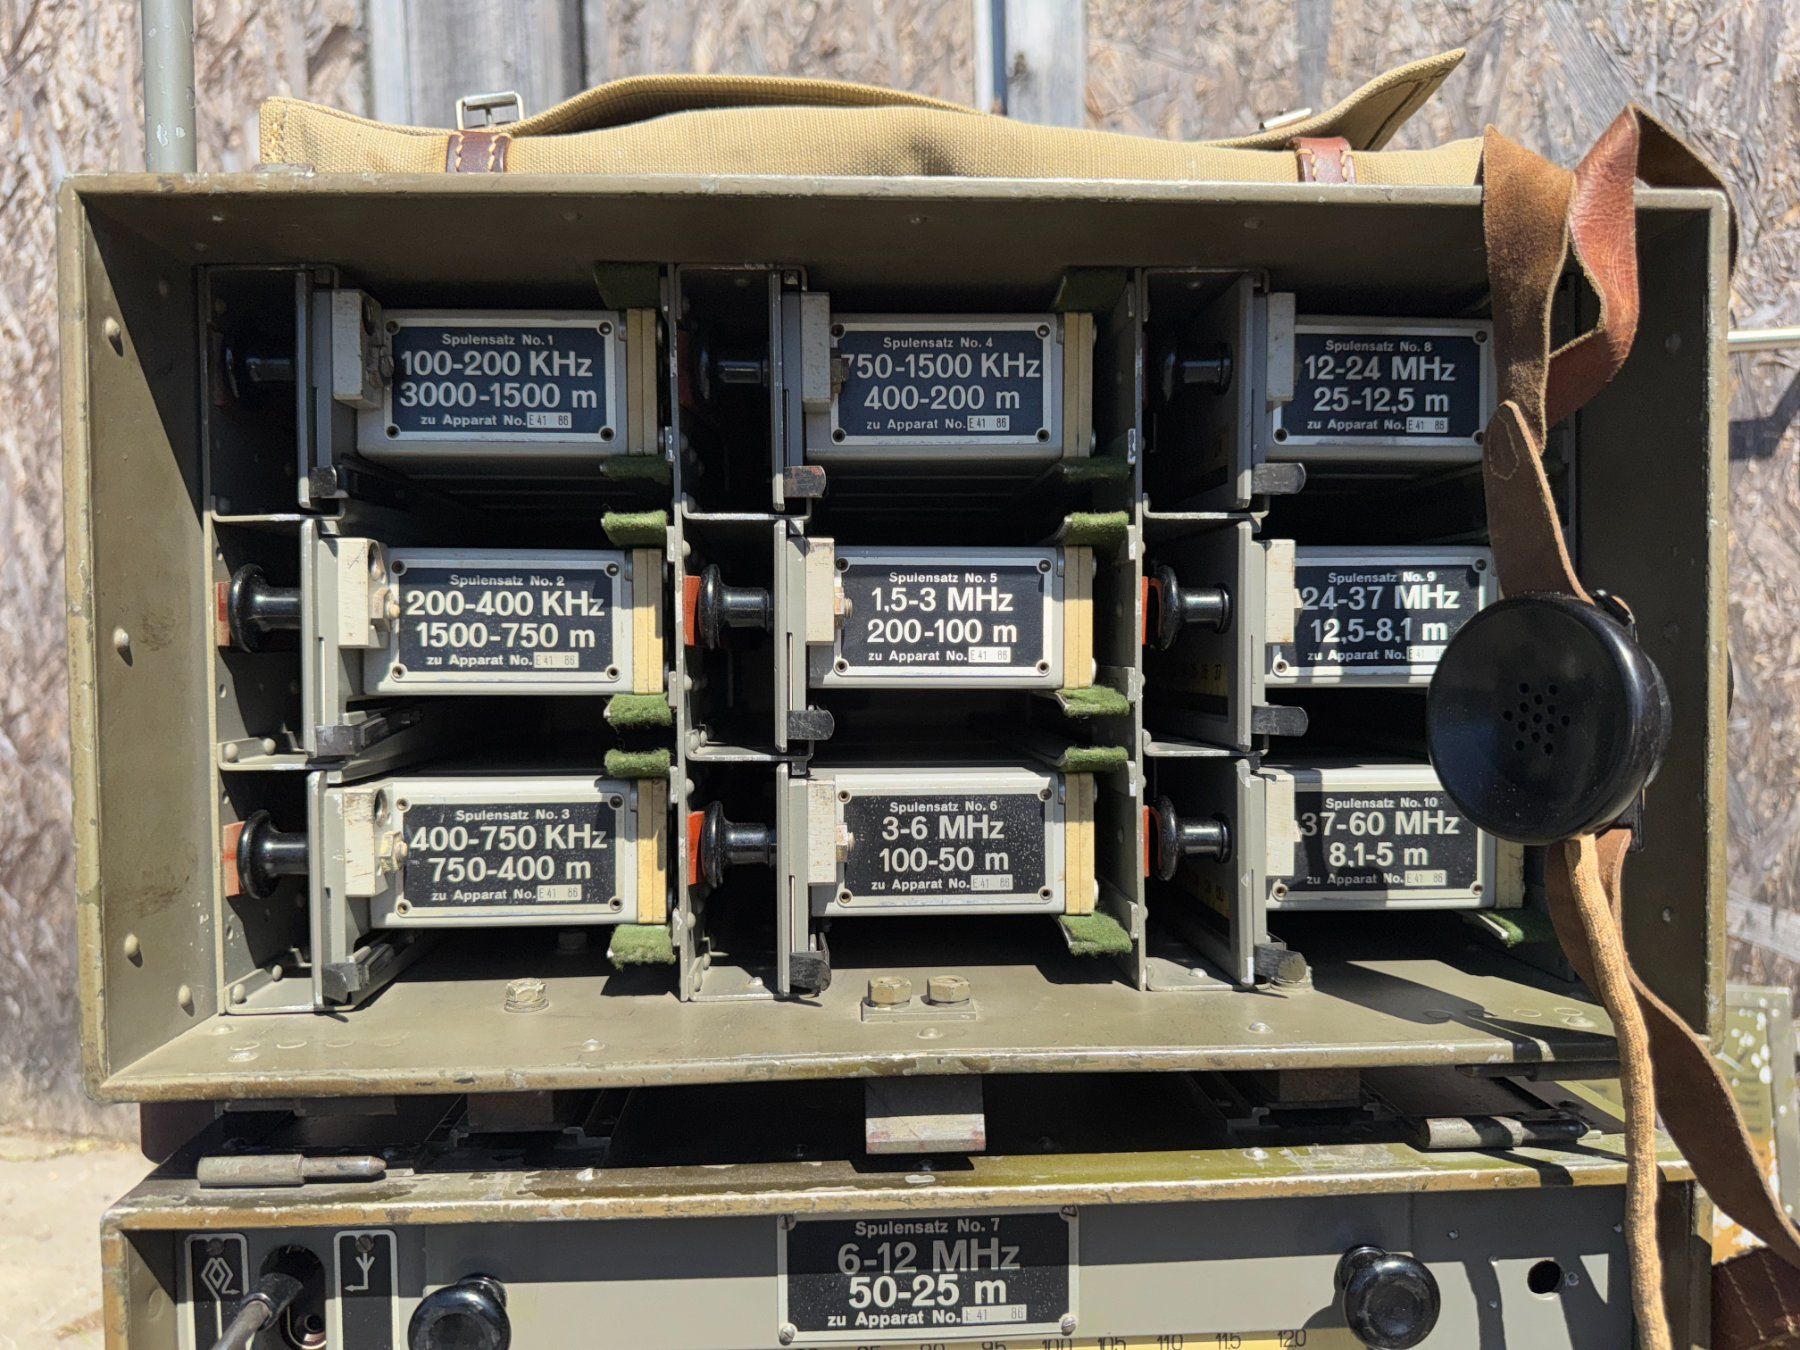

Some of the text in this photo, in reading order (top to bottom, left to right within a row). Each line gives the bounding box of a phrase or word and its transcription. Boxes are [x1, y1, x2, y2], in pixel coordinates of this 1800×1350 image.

[442, 334, 553, 347] Spulensatz No. 1
[883, 337, 993, 349] Spulensatz No. 4
[1325, 340, 1431, 352] Spulensatz No. 8
[401, 350, 592, 376] 100-200 KHz
[841, 353, 1040, 378] 750-1500 KHz
[1305, 355, 1456, 381] 12-24 MHz
[400, 381, 597, 408] 3000-1500 m
[864, 385, 1019, 410] 400-200 m
[1425, 394, 1448, 412] m
[420, 416, 436, 424] zu
[443, 415, 497, 427] Apparat
[504, 415, 526, 425] No.
[866, 421, 880, 429] zu
[887, 419, 938, 431] Apparat
[945, 419, 966, 429] No.
[969, 418, 974, 427] E
[976, 418, 985, 428] 41
[1307, 421, 1321, 429] zu
[1328, 420, 1378, 431] Apparat
[1384, 420, 1405, 430] No.
[450, 575, 565, 587] Spulensatz No. 2
[889, 572, 997, 584] Spulensatz No. 5
[1328, 572, 1437, 585] Spulensatz No. 9
[406, 590, 605, 616] 200-400 KHz
[948, 586, 1013, 611] MHz
[1302, 584, 1460, 610] 24-37 MHz
[416, 622, 595, 648] 1500-750 m
[867, 619, 1017, 643] 200-100 m
[1422, 623, 1448, 641] m
[427, 656, 442, 665] zu
[450, 654, 503, 667] Apparat
[510, 655, 532, 665] No.
[868, 652, 882, 660] zu
[889, 650, 939, 663] Apparat
[946, 651, 967, 660] No.
[1307, 652, 1322, 660] zu
[1328, 650, 1378, 661] Apparat
[1385, 650, 1406, 660] No.
[890, 801, 997, 814] Spulensatz No. 6
[1326, 797, 1437, 810] Spulensatz No. 10
[455, 809, 570, 822] Spulensatz No. 3
[1301, 810, 1460, 836] 37-60 MHz
[882, 815, 1004, 840] 3-6 MHz
[410, 824, 607, 851] 400-750 KHz
[879, 847, 1008, 872] 100-50 m
[1404, 847, 1428, 865] m
[428, 856, 591, 882] 750-400 m
[871, 882, 885, 890] zu
[892, 879, 942, 891] Apparat
[949, 878, 970, 888] No.
[1307, 876, 1320, 884] zu
[1327, 874, 1377, 885] Apparat
[1383, 874, 1404, 883] No.
[432, 892, 447, 900] zu
[453, 890, 507, 902] Apparat
[513, 889, 536, 899] No.
[855, 1218, 1000, 1238] Spulensatz No. 7
[838, 1238, 1020, 1275] 6-12 MHz
[849, 1274, 1006, 1309] 50-25 m
[828, 1314, 846, 1326] zu
[855, 1311, 924, 1328] Apparat
[932, 1310, 961, 1324] No.
[976, 1309, 988, 1320] 41
